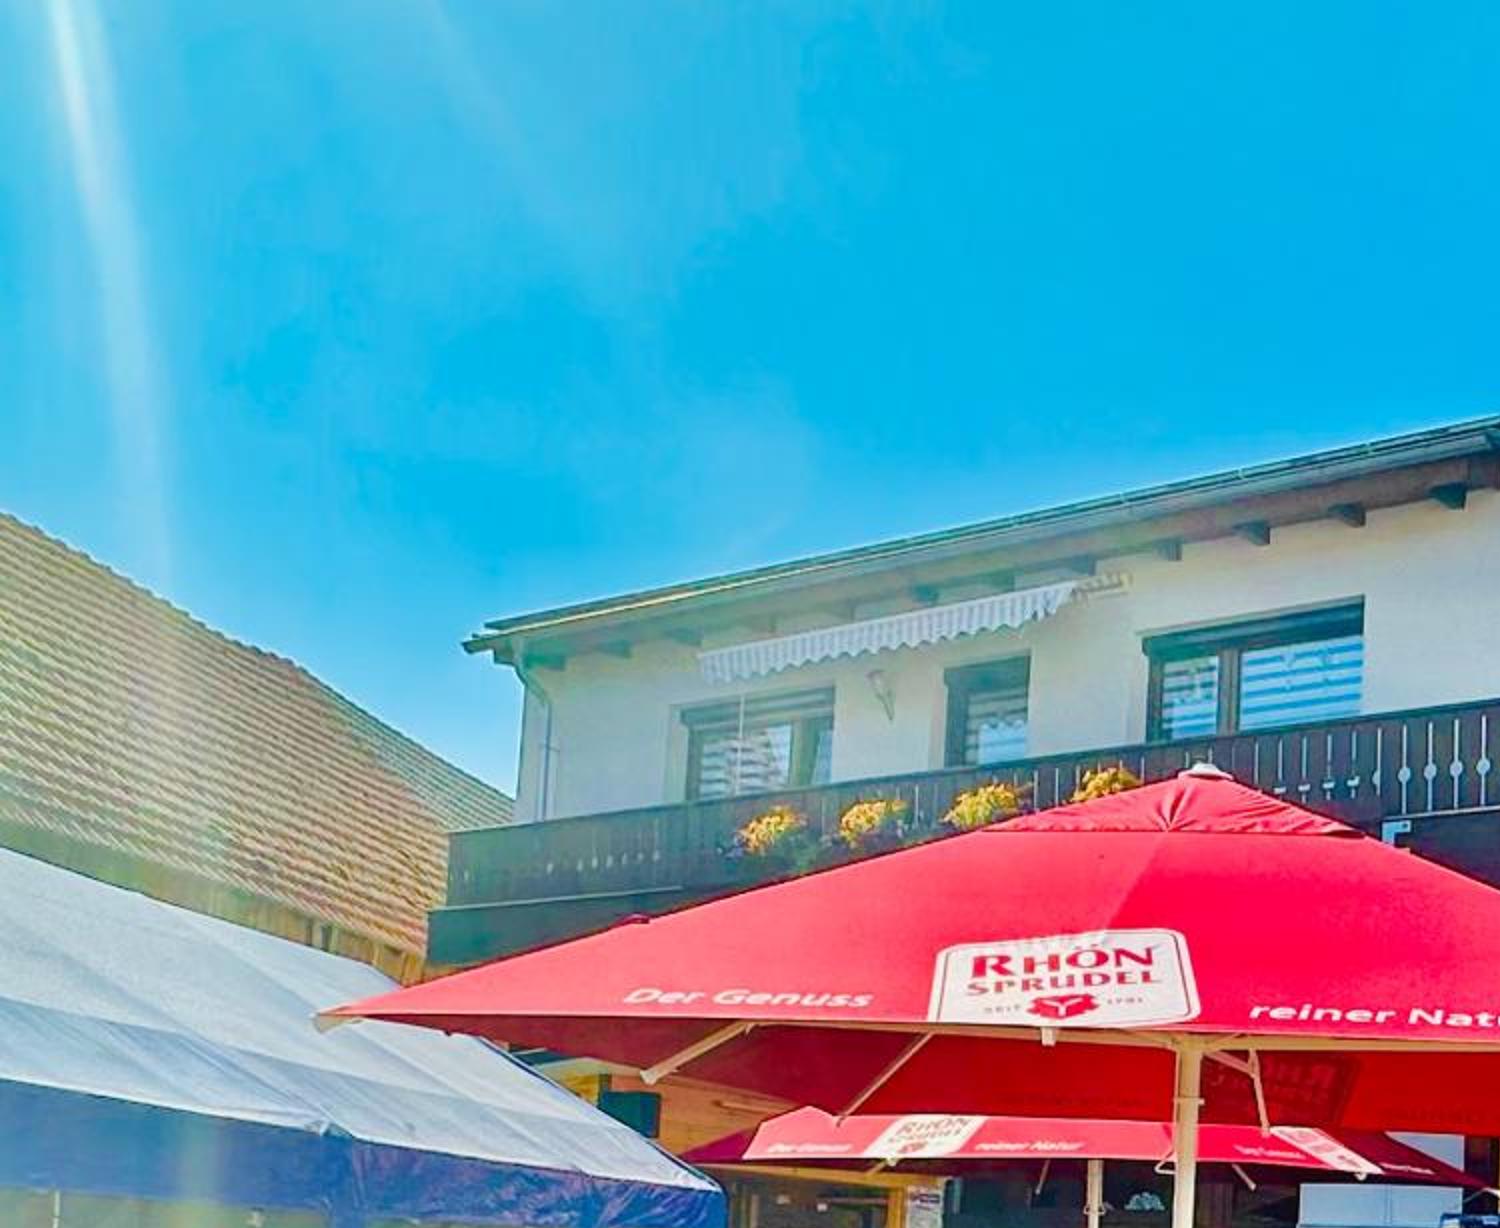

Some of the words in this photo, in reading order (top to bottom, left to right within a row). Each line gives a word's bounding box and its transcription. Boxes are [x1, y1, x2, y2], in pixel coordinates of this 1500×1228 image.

[971, 944, 1156, 978] RHÖN
[966, 970, 1161, 997] SPRUDEL
[625, 987, 706, 1005] Der
[712, 988, 873, 1008] Genuss
[1250, 1003, 1397, 1024] reiner
